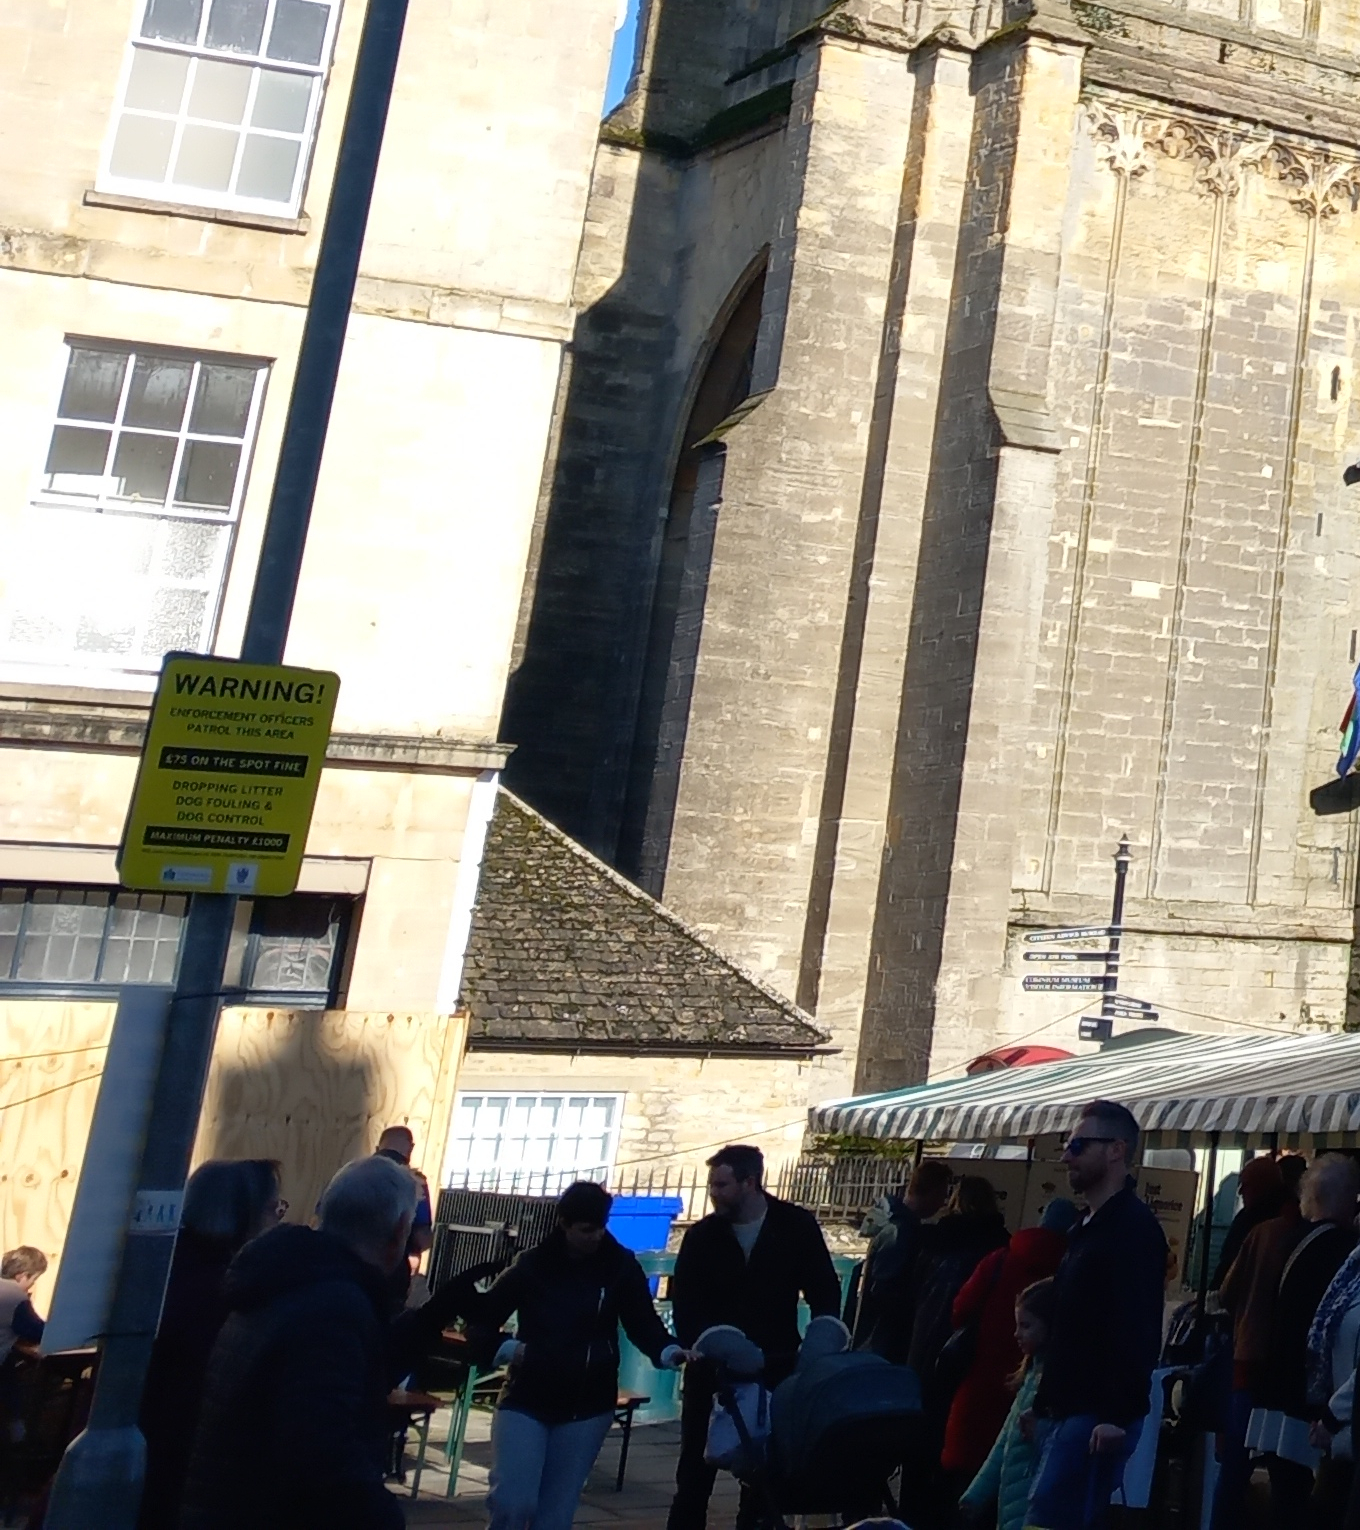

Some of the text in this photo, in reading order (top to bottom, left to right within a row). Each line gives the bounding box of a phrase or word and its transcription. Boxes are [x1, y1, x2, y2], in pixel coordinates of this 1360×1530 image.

[175, 673, 325, 705] WARNING!
[169, 707, 314, 727] ENFORCEMENT OFFICERS
[187, 723, 295, 740] PATROL THIS AREA
[190, 755, 210, 766] ON
[213, 756, 237, 768] THE
[239, 759, 273, 770] SPOT
[273, 760, 302, 772] FINE
[172, 780, 284, 797] DROPPING LITTER
[176, 796, 273, 811] DOG FOULING &
[177, 811, 265, 826] DOG CONTROL
[150, 831, 283, 848] MAXIMUM PENALTY £1000
